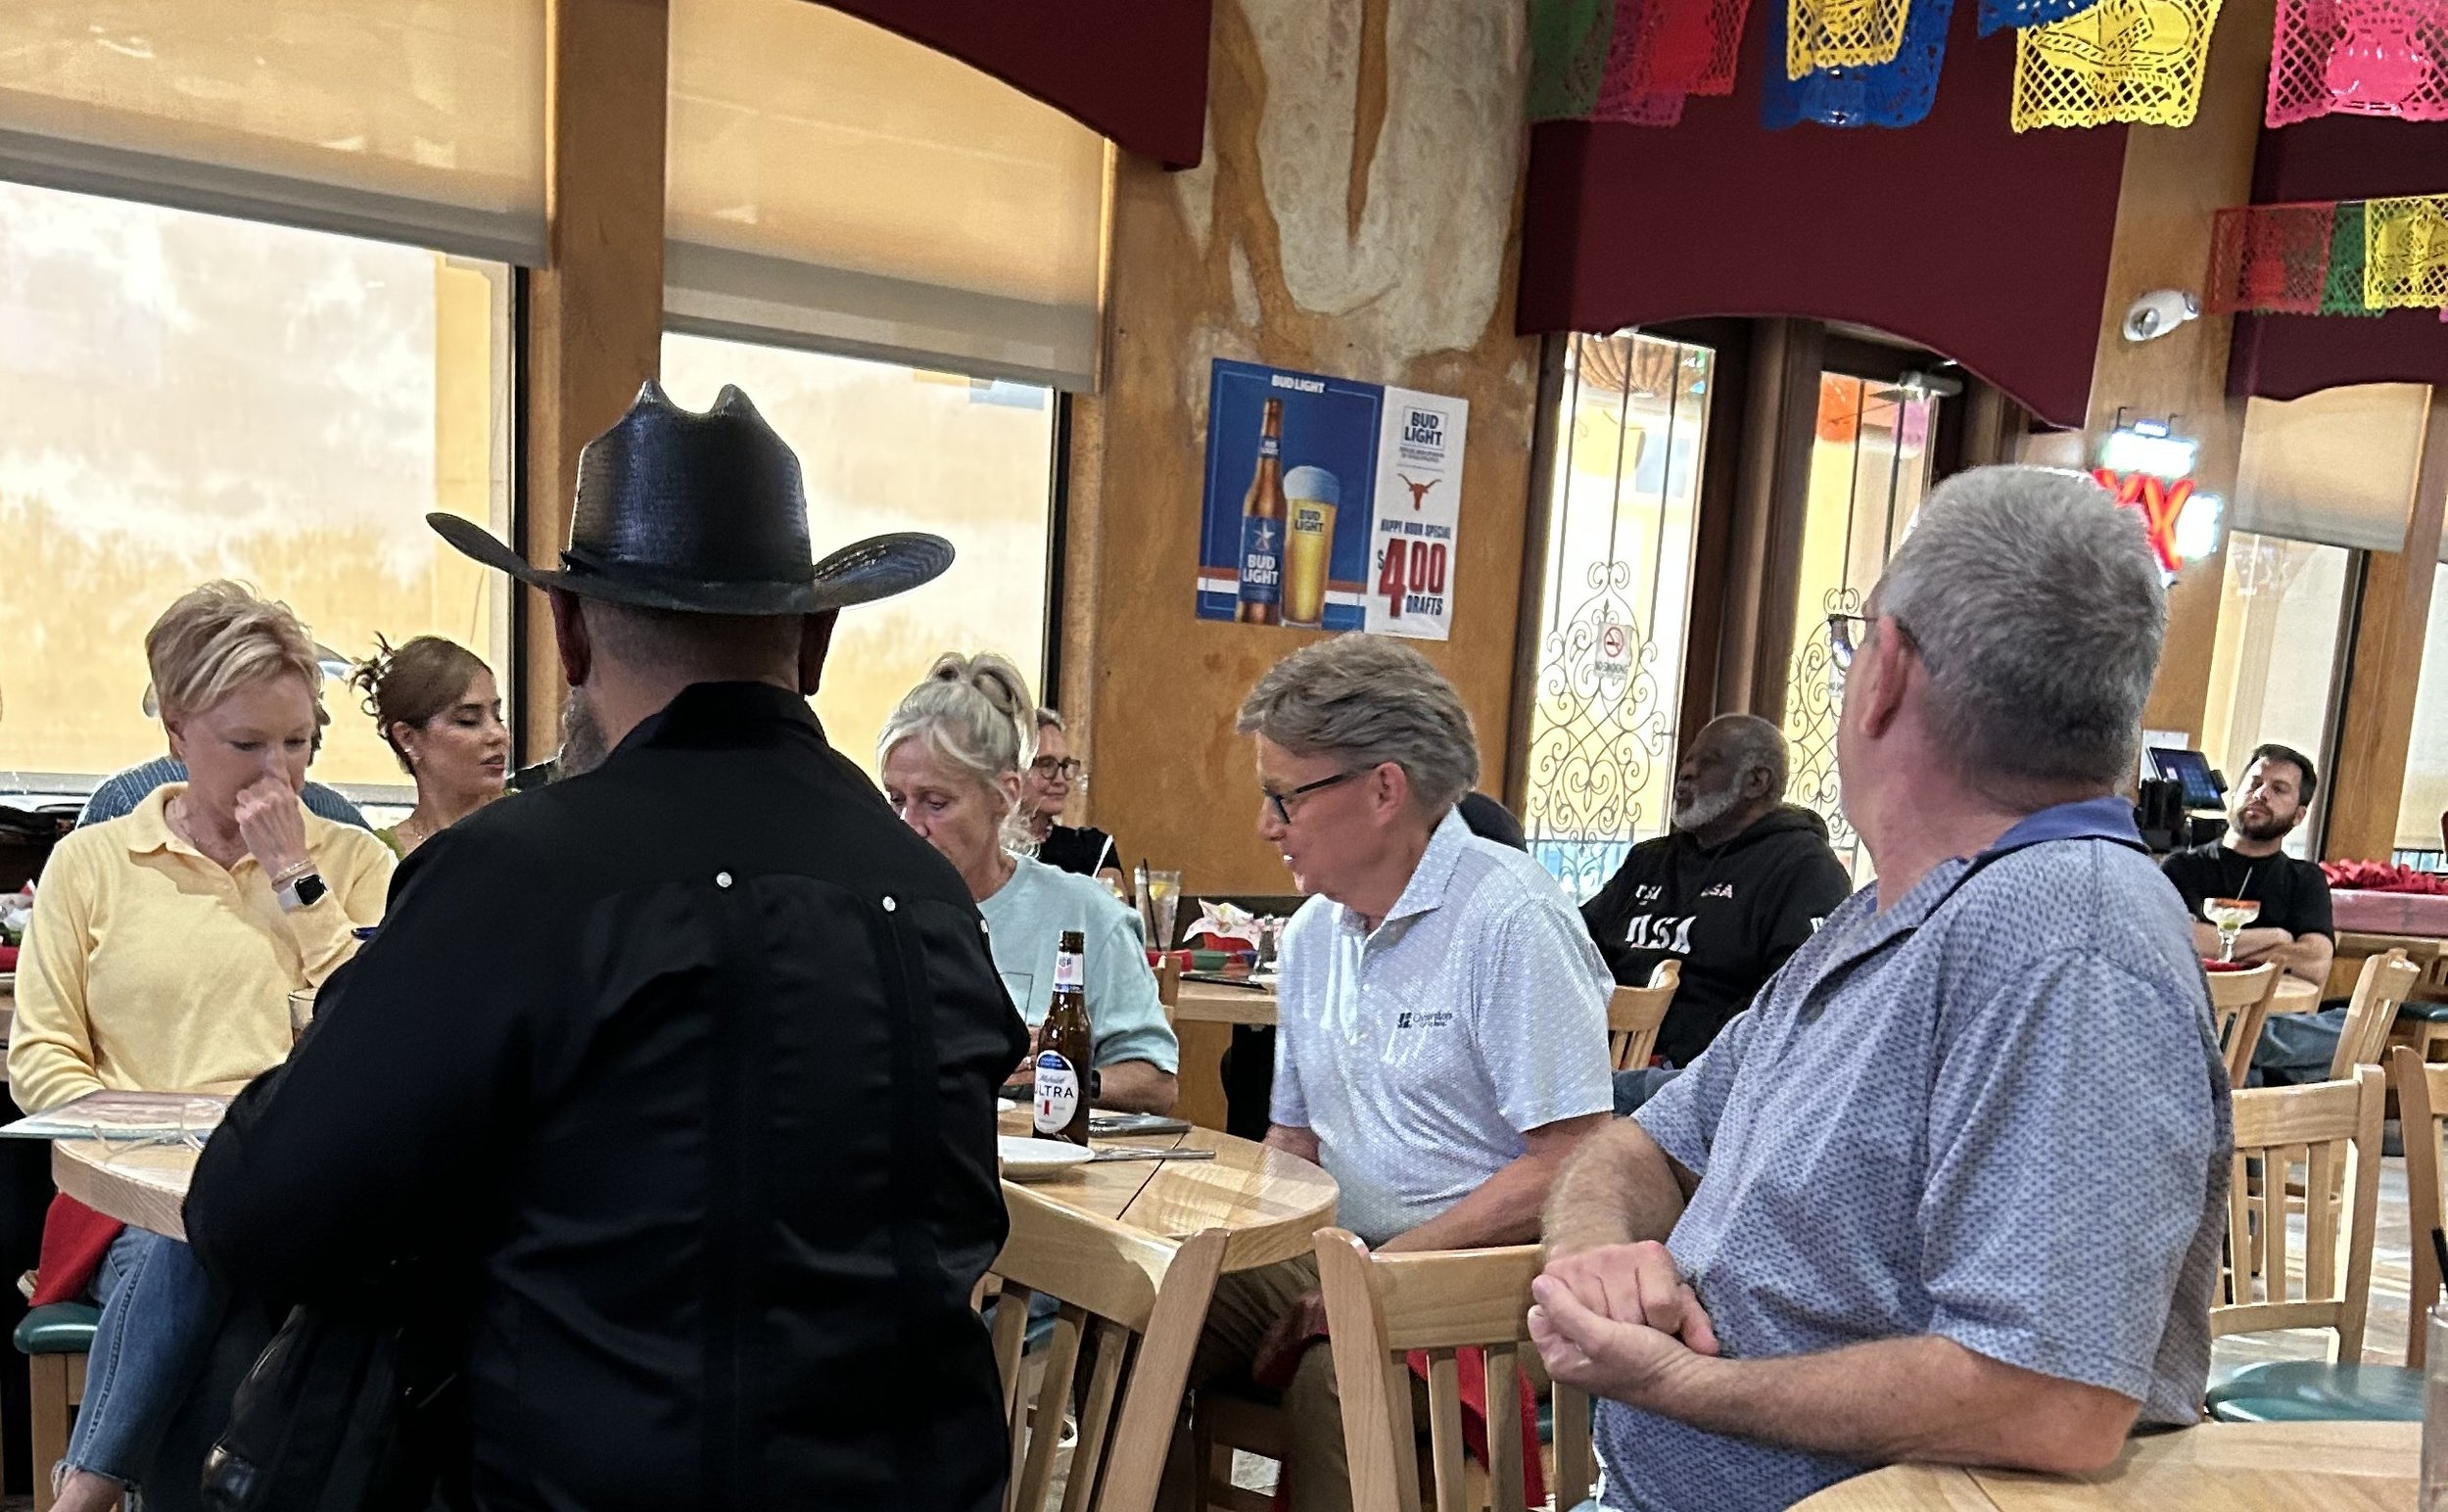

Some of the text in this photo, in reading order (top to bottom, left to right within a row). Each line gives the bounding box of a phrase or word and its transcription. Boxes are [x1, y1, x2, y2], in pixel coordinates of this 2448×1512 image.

[1271, 375, 1325, 394] BUD LIGHT
[1411, 411, 1439, 429] BUD
[1404, 426, 1442, 446] LIGHT
[1299, 509, 1321, 521] BUD
[1295, 520, 1325, 533] LIGHT
[1381, 518, 1451, 540] HAPPY HOUR SPECIAL
[1248, 553, 1276, 570] BUD
[1243, 568, 1279, 585] LIGHT
[1406, 595, 1443, 616] DRAFTS
